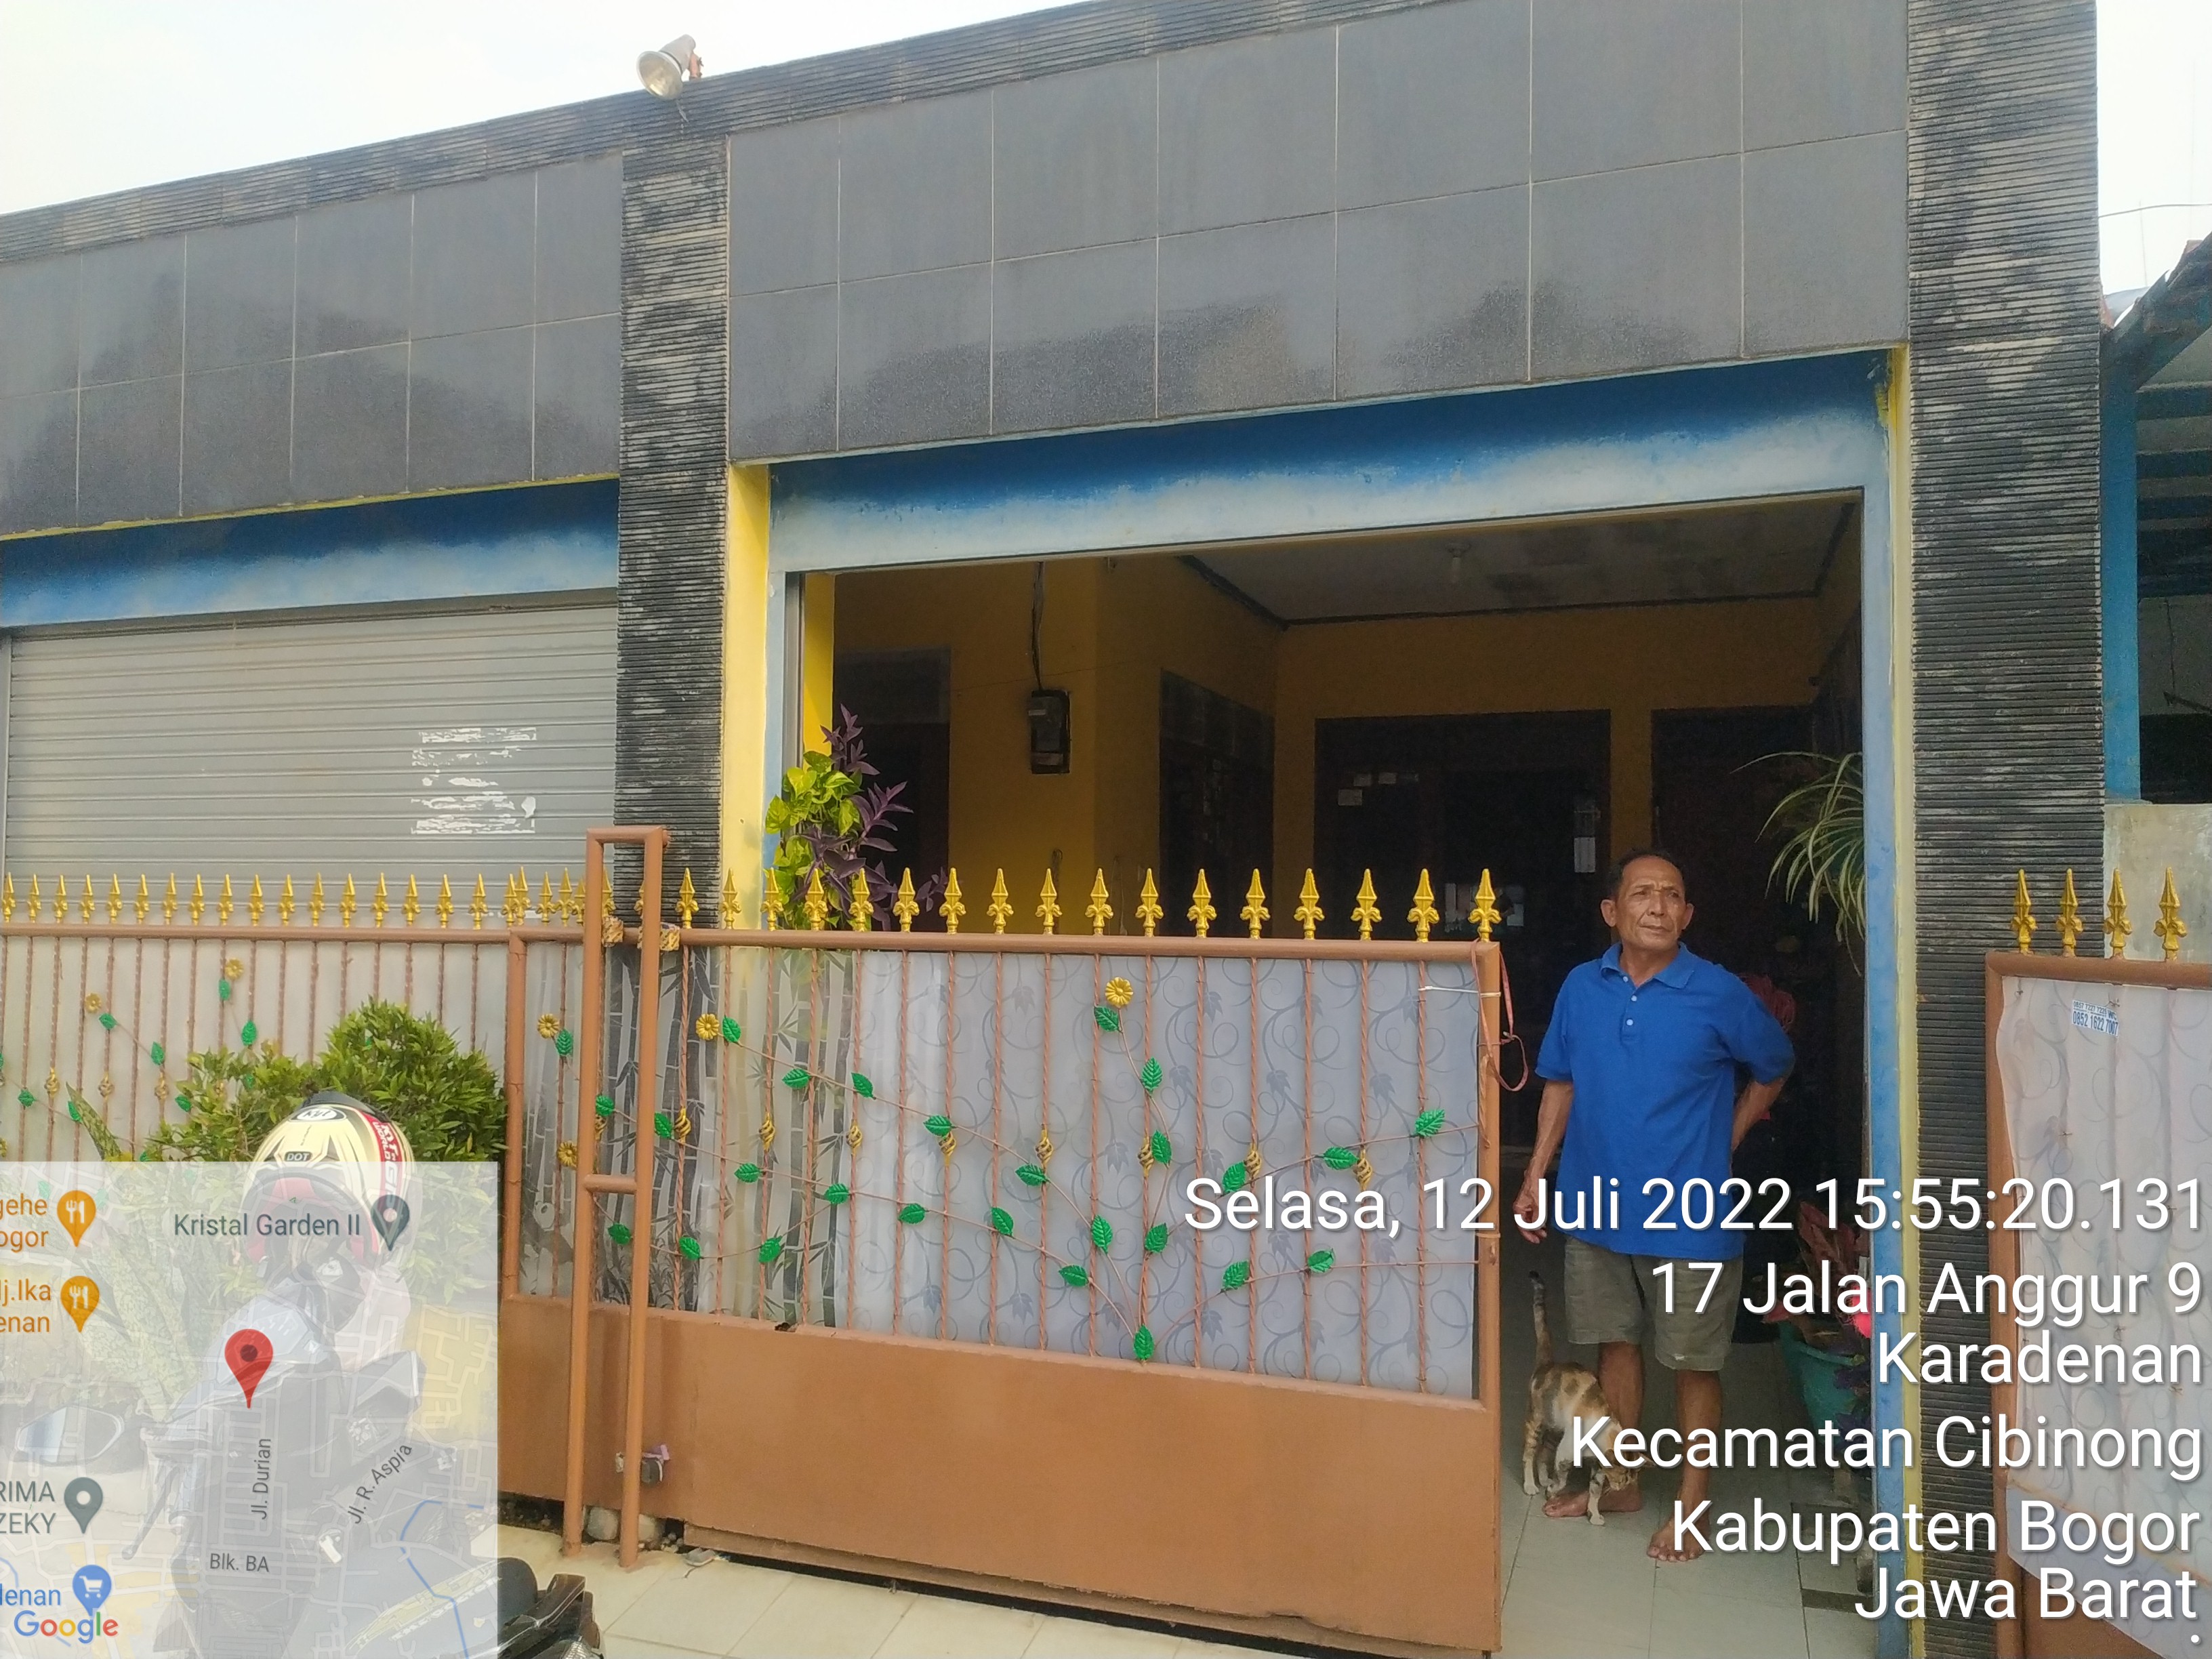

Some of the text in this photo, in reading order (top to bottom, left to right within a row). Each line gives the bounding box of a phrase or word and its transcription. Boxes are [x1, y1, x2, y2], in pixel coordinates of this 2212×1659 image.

[2073, 1010, 2088, 1027] 0852
[2090, 1015, 2104, 1031] 1622
[2106, 1019, 2118, 1036] 7007
[287, 1153, 310, 1161] DOT
